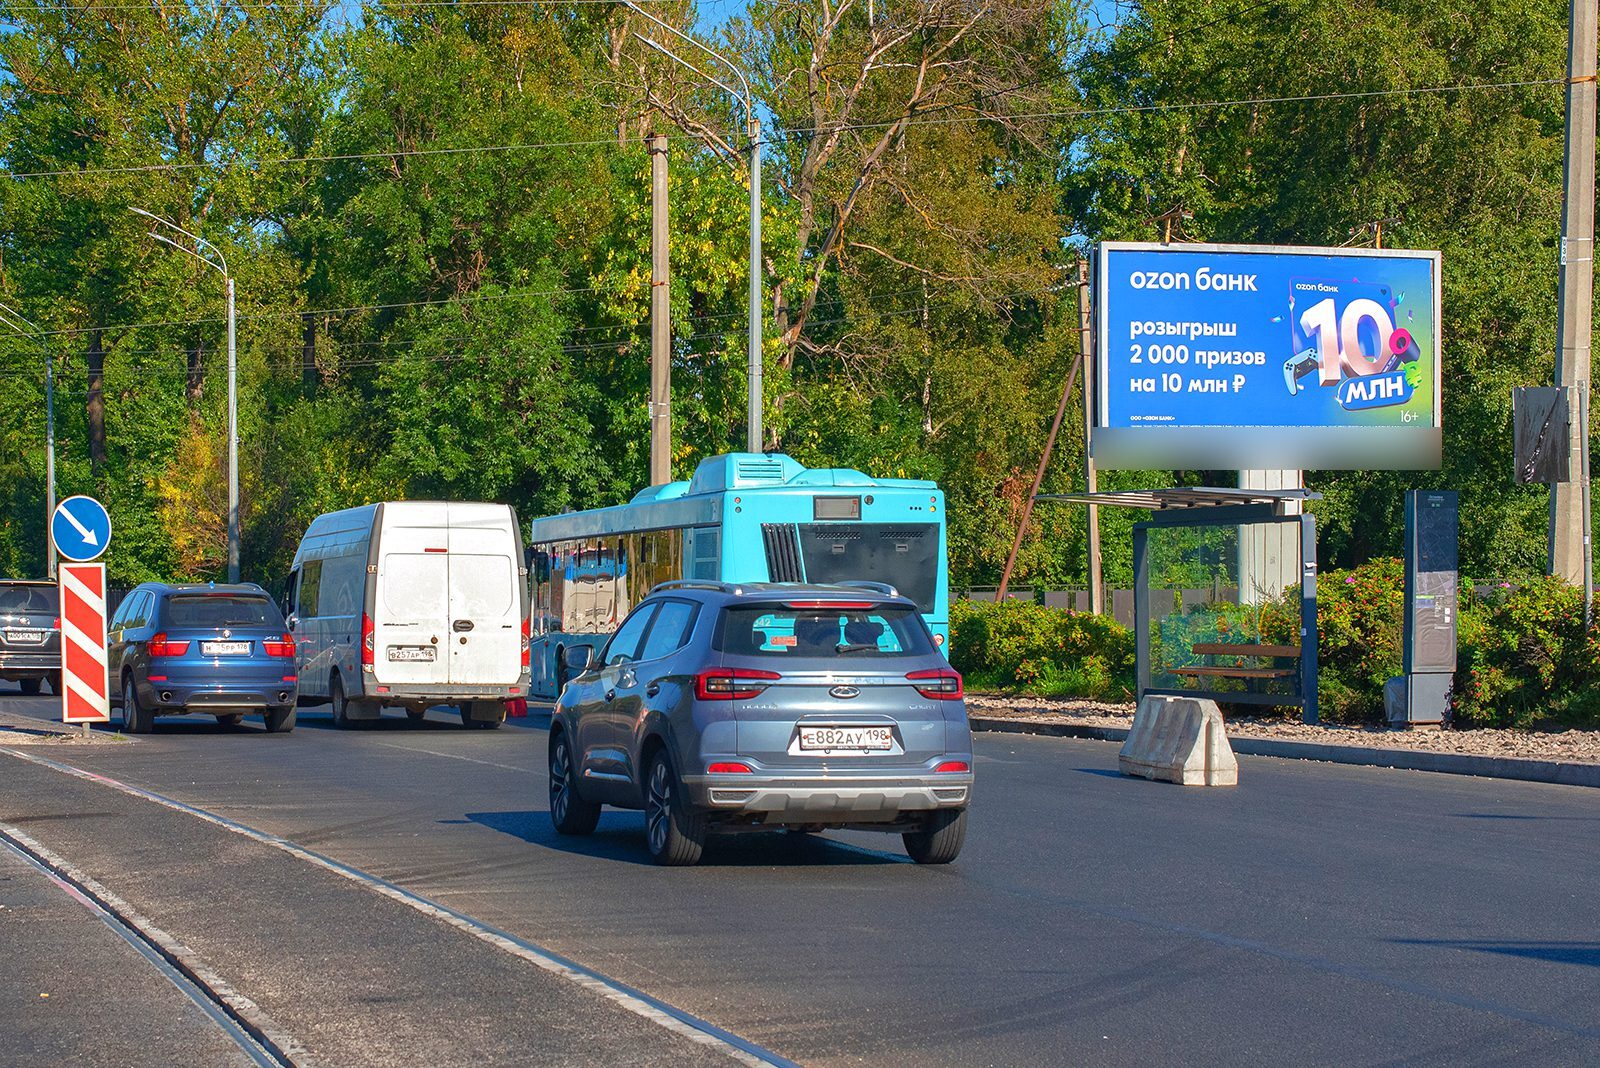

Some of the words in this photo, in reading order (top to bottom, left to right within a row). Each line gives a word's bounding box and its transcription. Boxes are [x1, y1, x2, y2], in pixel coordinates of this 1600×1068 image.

[1129, 271, 1189, 290] ozon
[1195, 266, 1258, 292] банк
[1295, 283, 1317, 291] ozon
[1318, 283, 1339, 293] банк
[1130, 320, 1237, 340] розыгрыш
[1299, 297, 1395, 387] 10
[1130, 345, 1142, 364] 2
[1148, 345, 1189, 365] 000
[1195, 350, 1266, 369] призов
[1130, 377, 1155, 393] на
[1161, 374, 1182, 392] 10
[1188, 378, 1228, 393] млн
[1400, 410, 1419, 423] 16+
[807, 730, 863, 745] Е882АУ
[866, 729, 887, 741] 198
